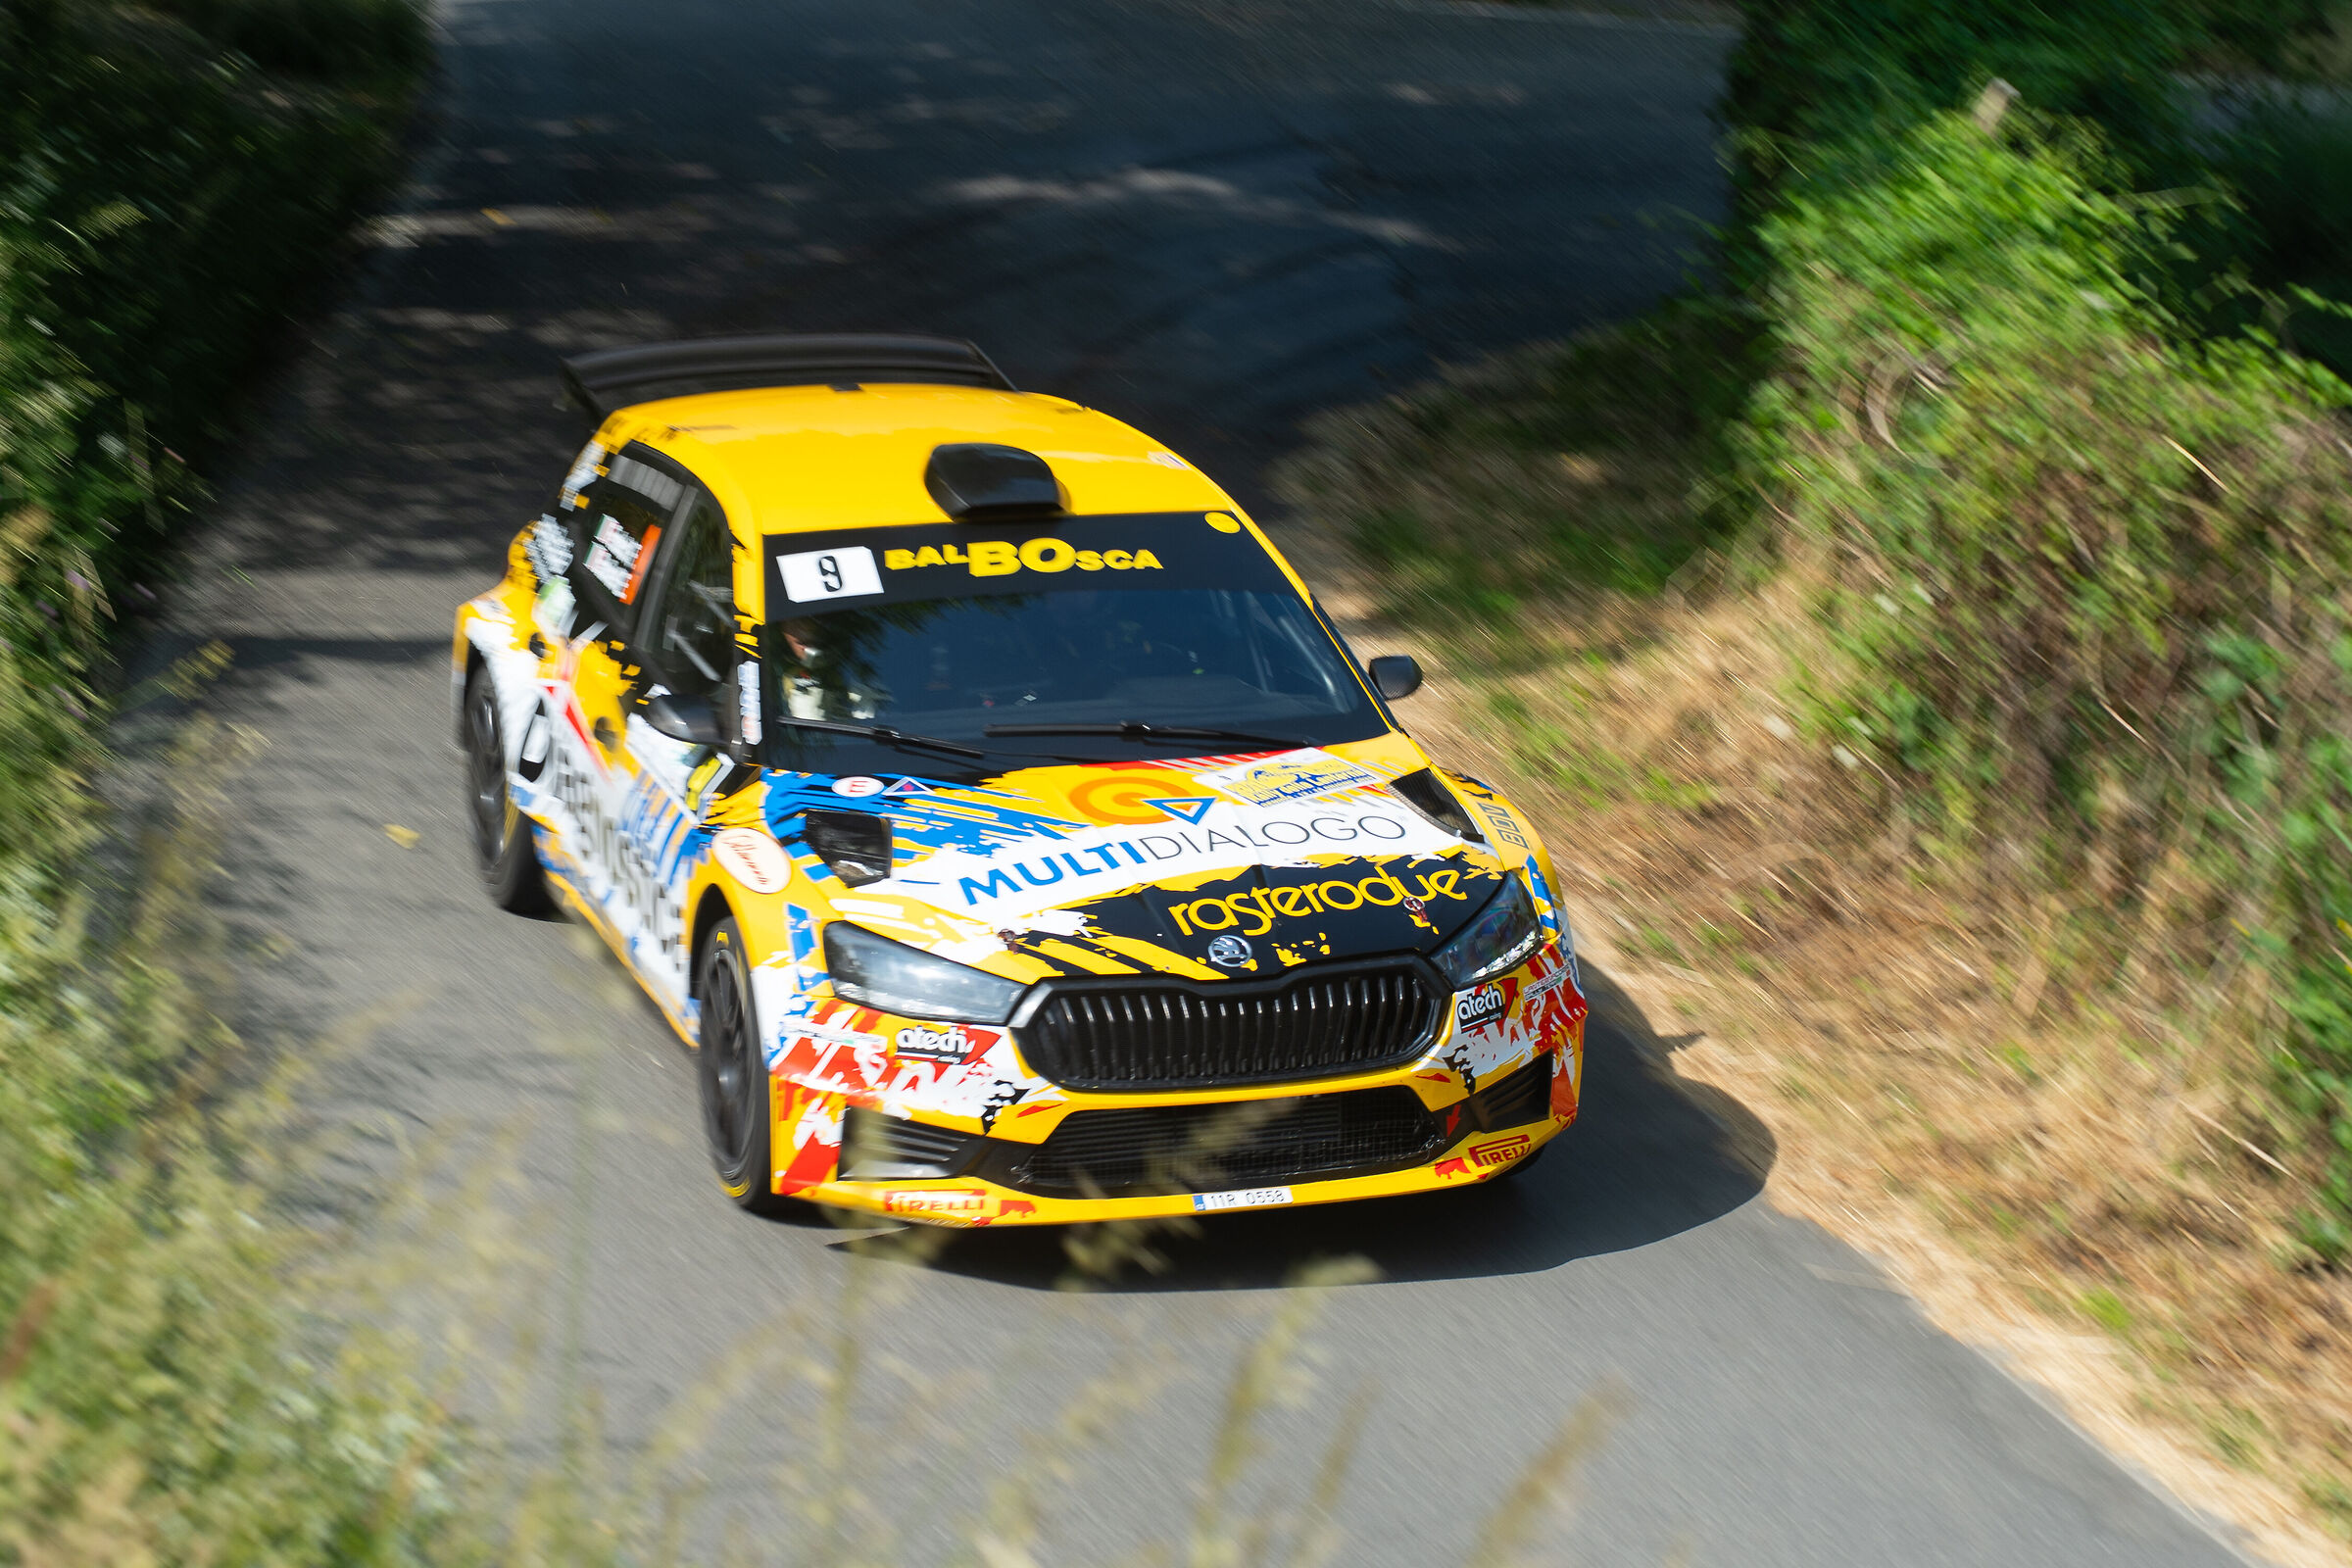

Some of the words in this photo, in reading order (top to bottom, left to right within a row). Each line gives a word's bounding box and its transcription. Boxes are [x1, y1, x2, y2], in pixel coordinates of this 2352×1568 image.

[819, 555, 843, 593] 9
[884, 538, 1164, 577] BALBOSCA
[957, 815, 1405, 906] MULTIDIALOGO
[1168, 865, 1468, 937] rasterodue
[1457, 983, 1503, 1020] atech
[896, 1025, 967, 1054] atech
[1468, 1135, 1531, 1168] PIRELLI
